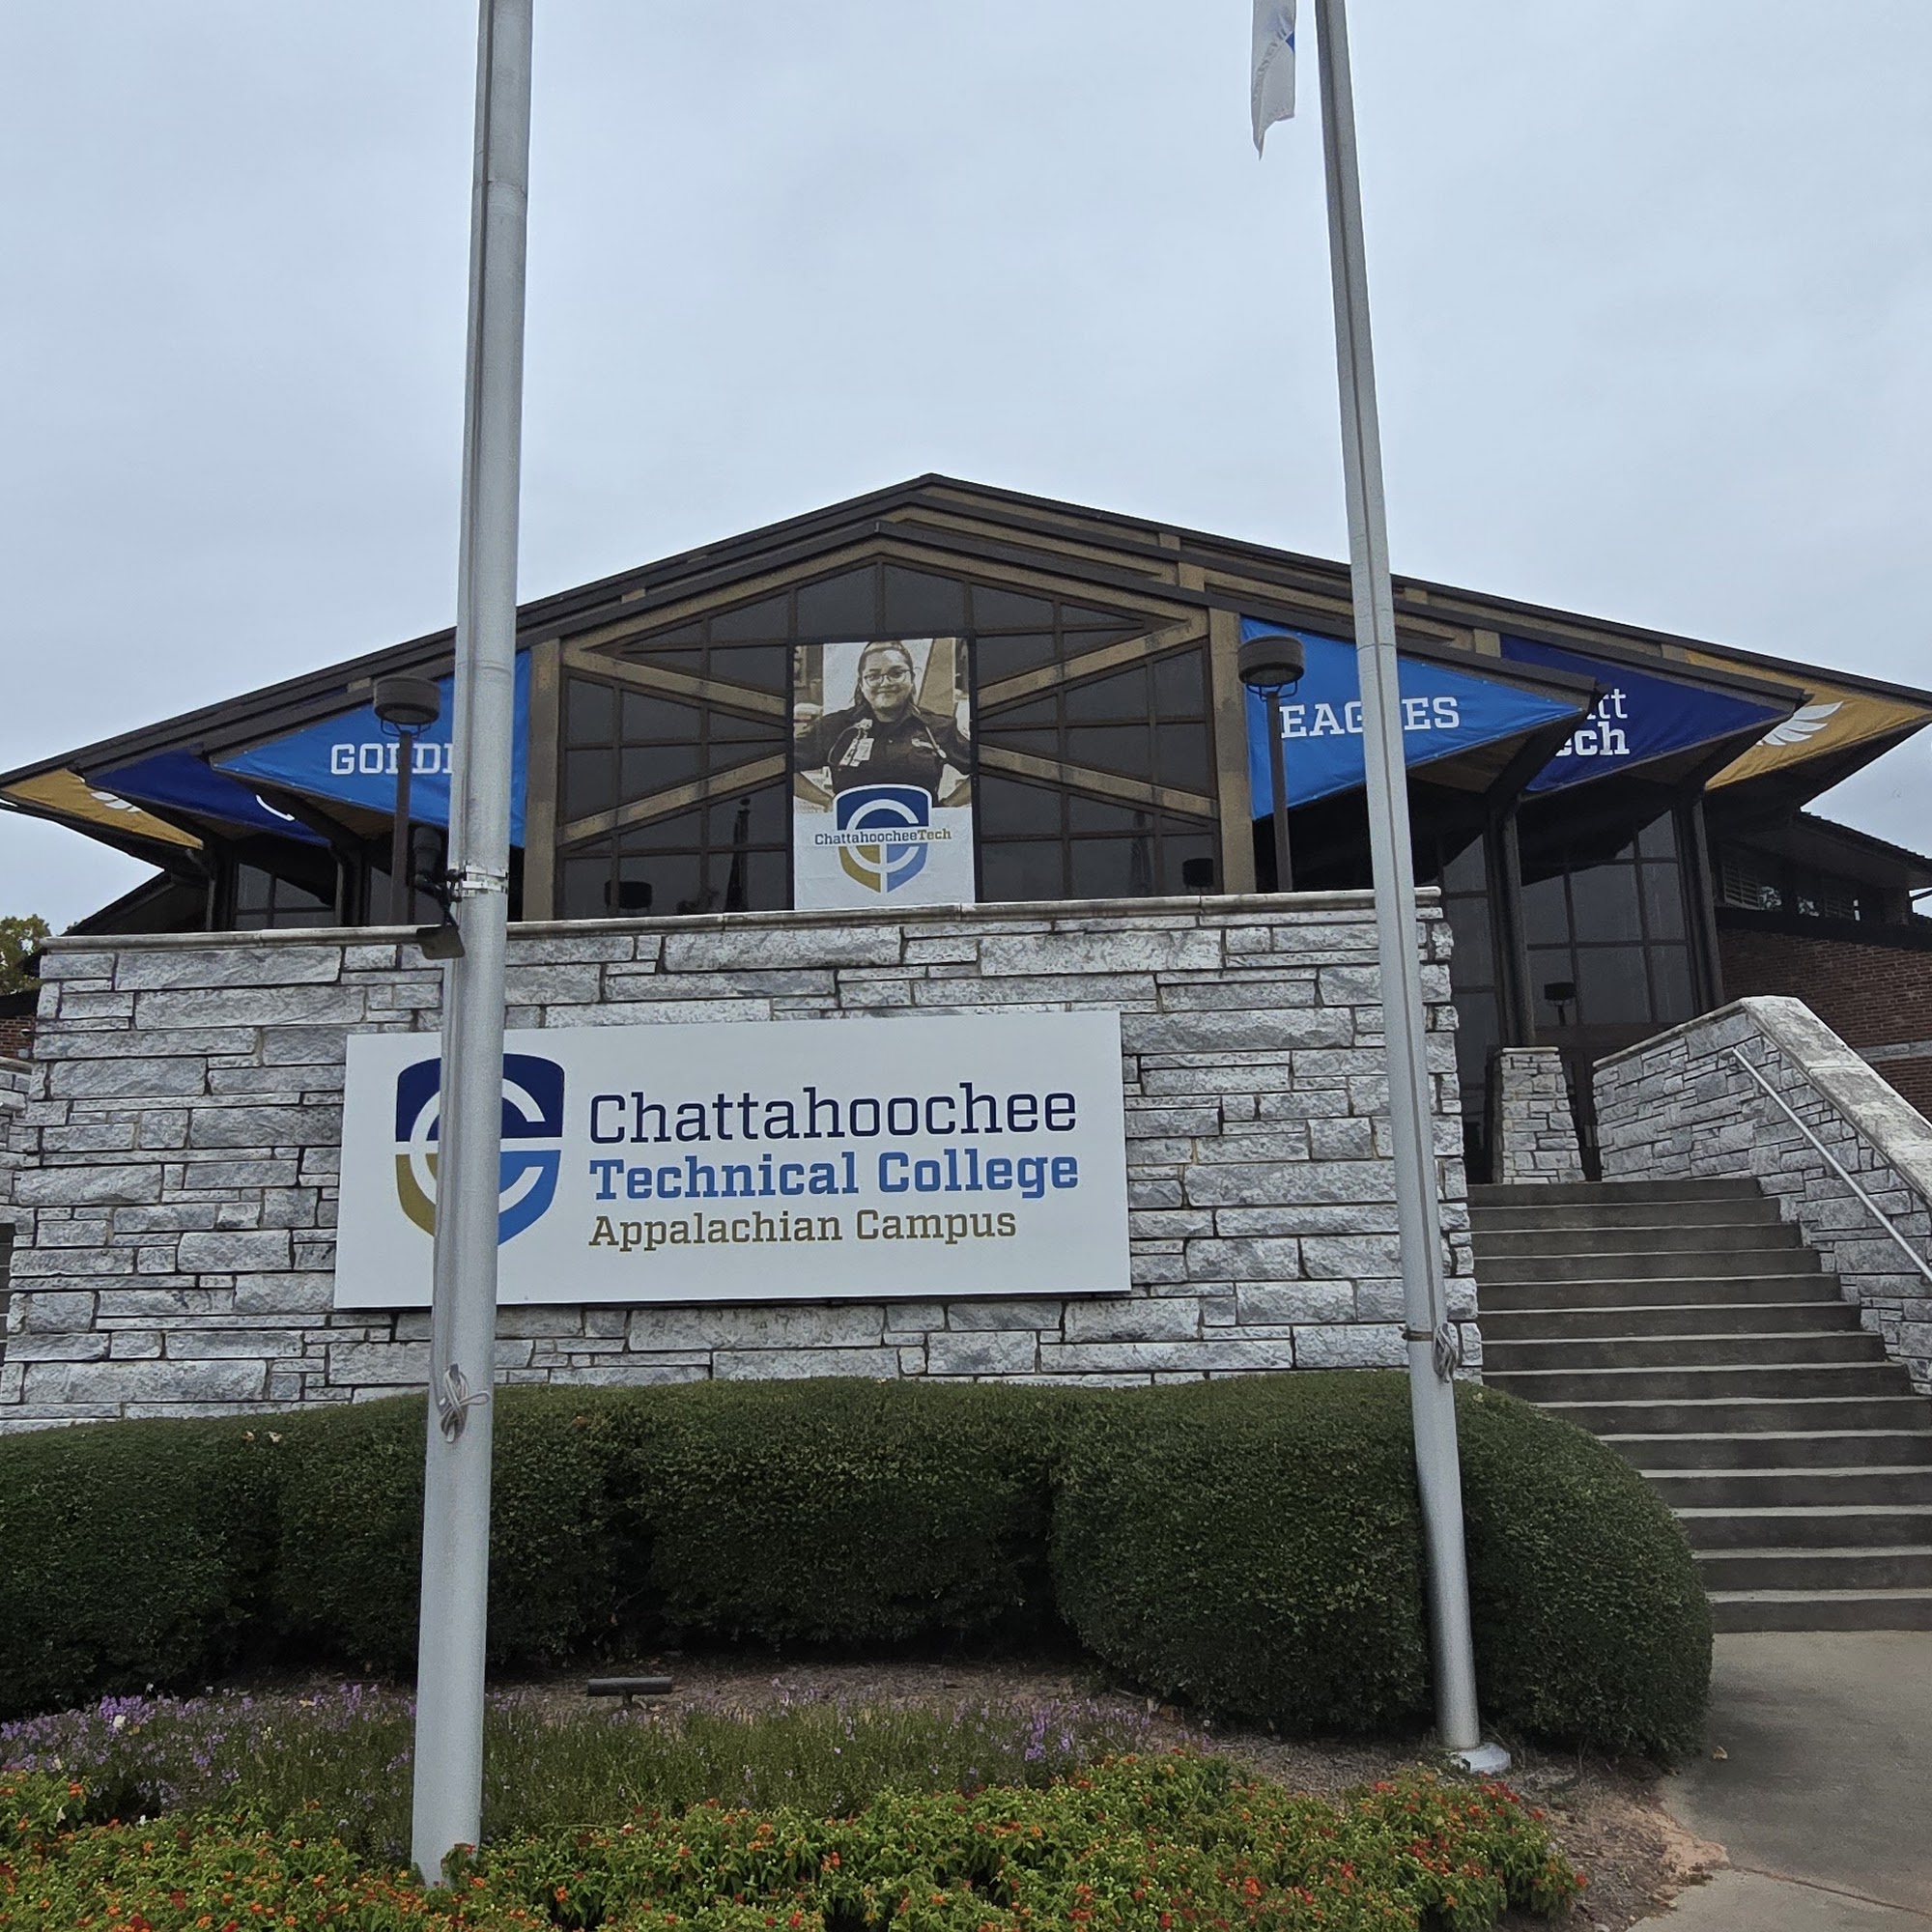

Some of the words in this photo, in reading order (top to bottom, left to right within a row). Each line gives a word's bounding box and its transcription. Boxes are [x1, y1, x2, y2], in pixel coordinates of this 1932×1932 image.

[1278, 696, 1461, 739] EAGES
[814, 828, 952, 845] ChattahoocheeTech
[589, 1081, 1076, 1145] Chattahoochee
[589, 1151, 859, 1201] Technical
[878, 1148, 1079, 1199] College
[588, 1209, 842, 1253] Appalachian
[856, 1209, 1016, 1245] Campus
